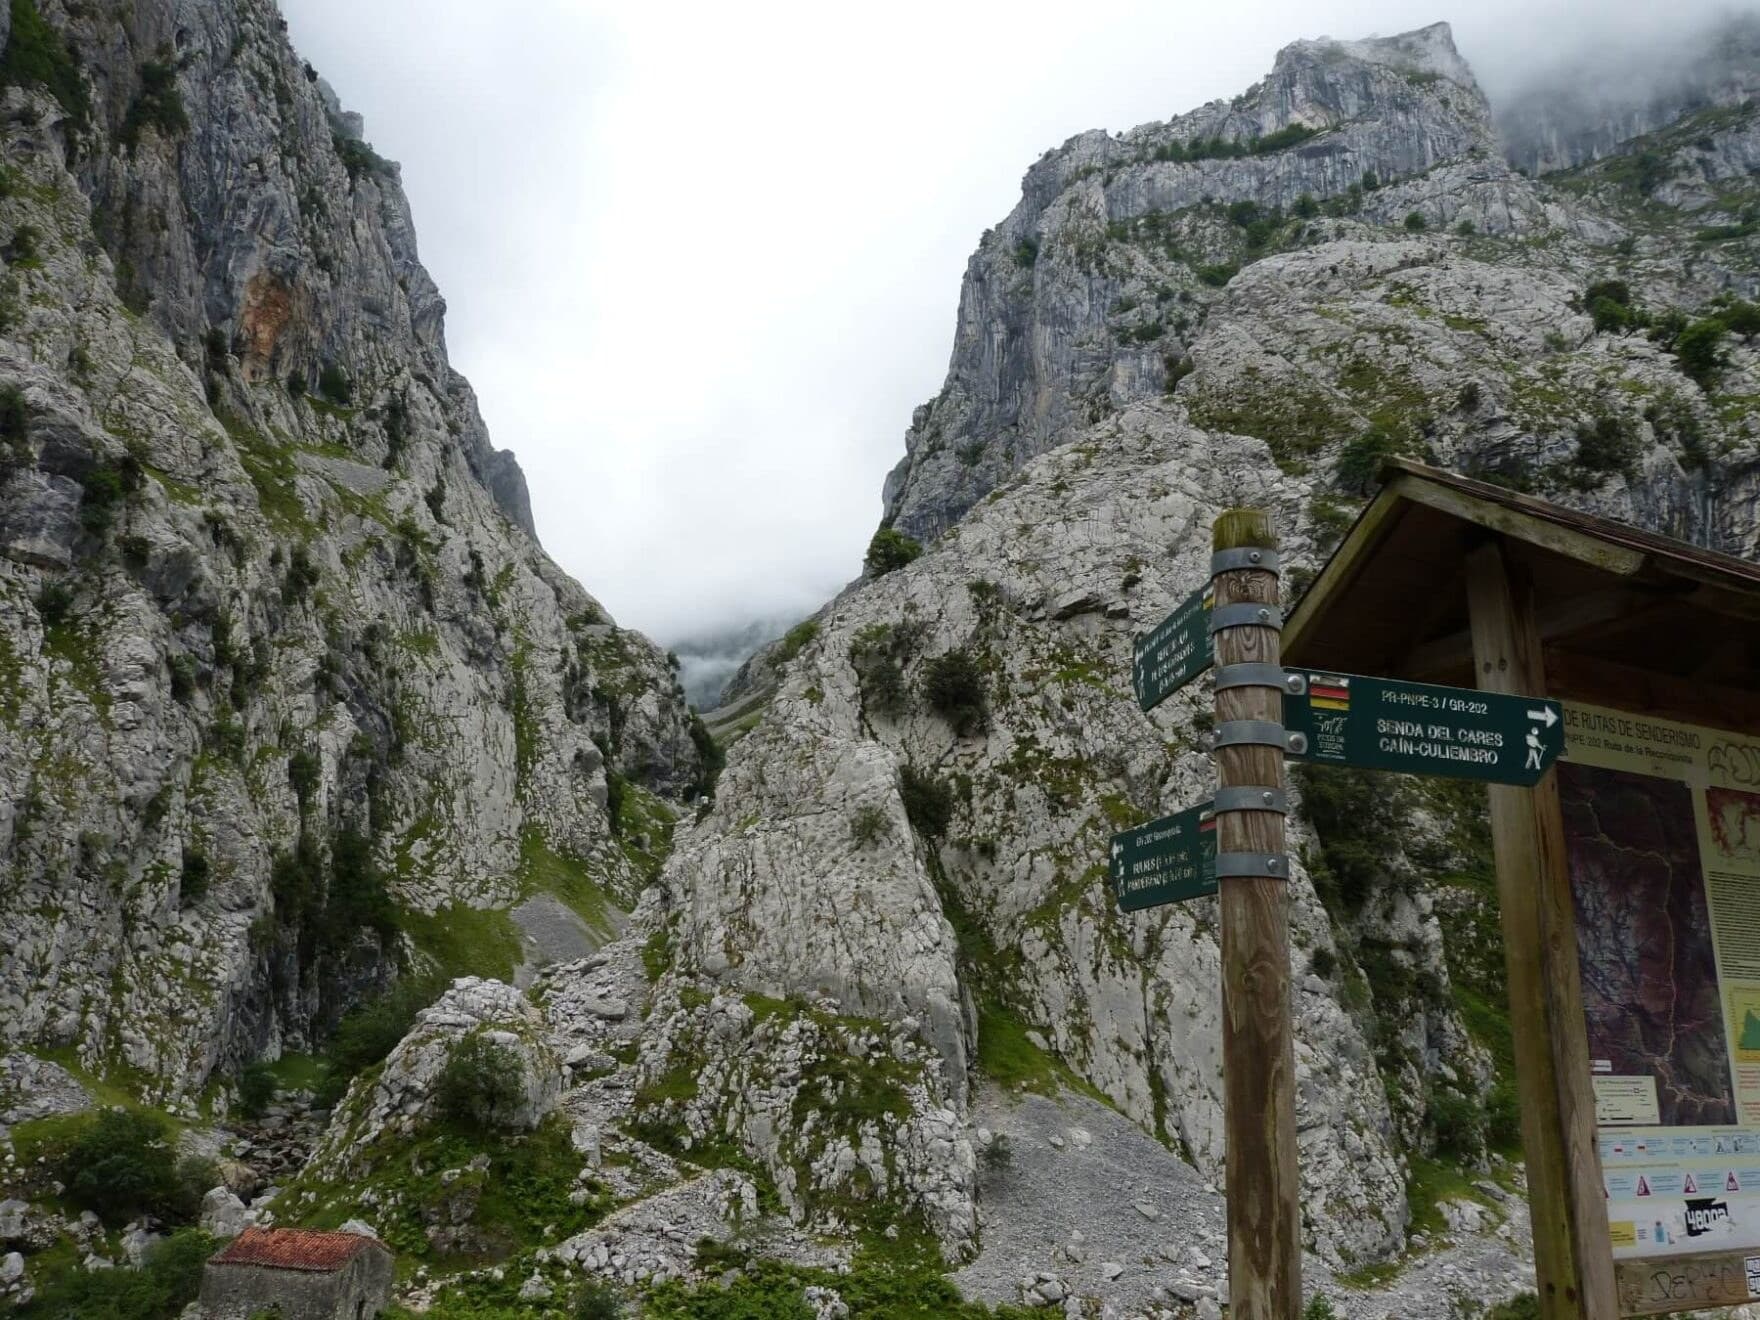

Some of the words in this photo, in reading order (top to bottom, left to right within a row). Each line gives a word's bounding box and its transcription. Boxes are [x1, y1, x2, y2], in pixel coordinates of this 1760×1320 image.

[1448, 699, 1489, 715] GR-202
[1376, 718, 1425, 739] SENDA
[1427, 724, 1454, 742] DEL
[1458, 727, 1504, 748] CARES
[1581, 712, 1616, 734] RUTAS
[1617, 719, 1633, 737] DE
[1634, 722, 1702, 750] SENDERISMO
[1379, 737, 1499, 766] CAÍN-CULIEMBRO
